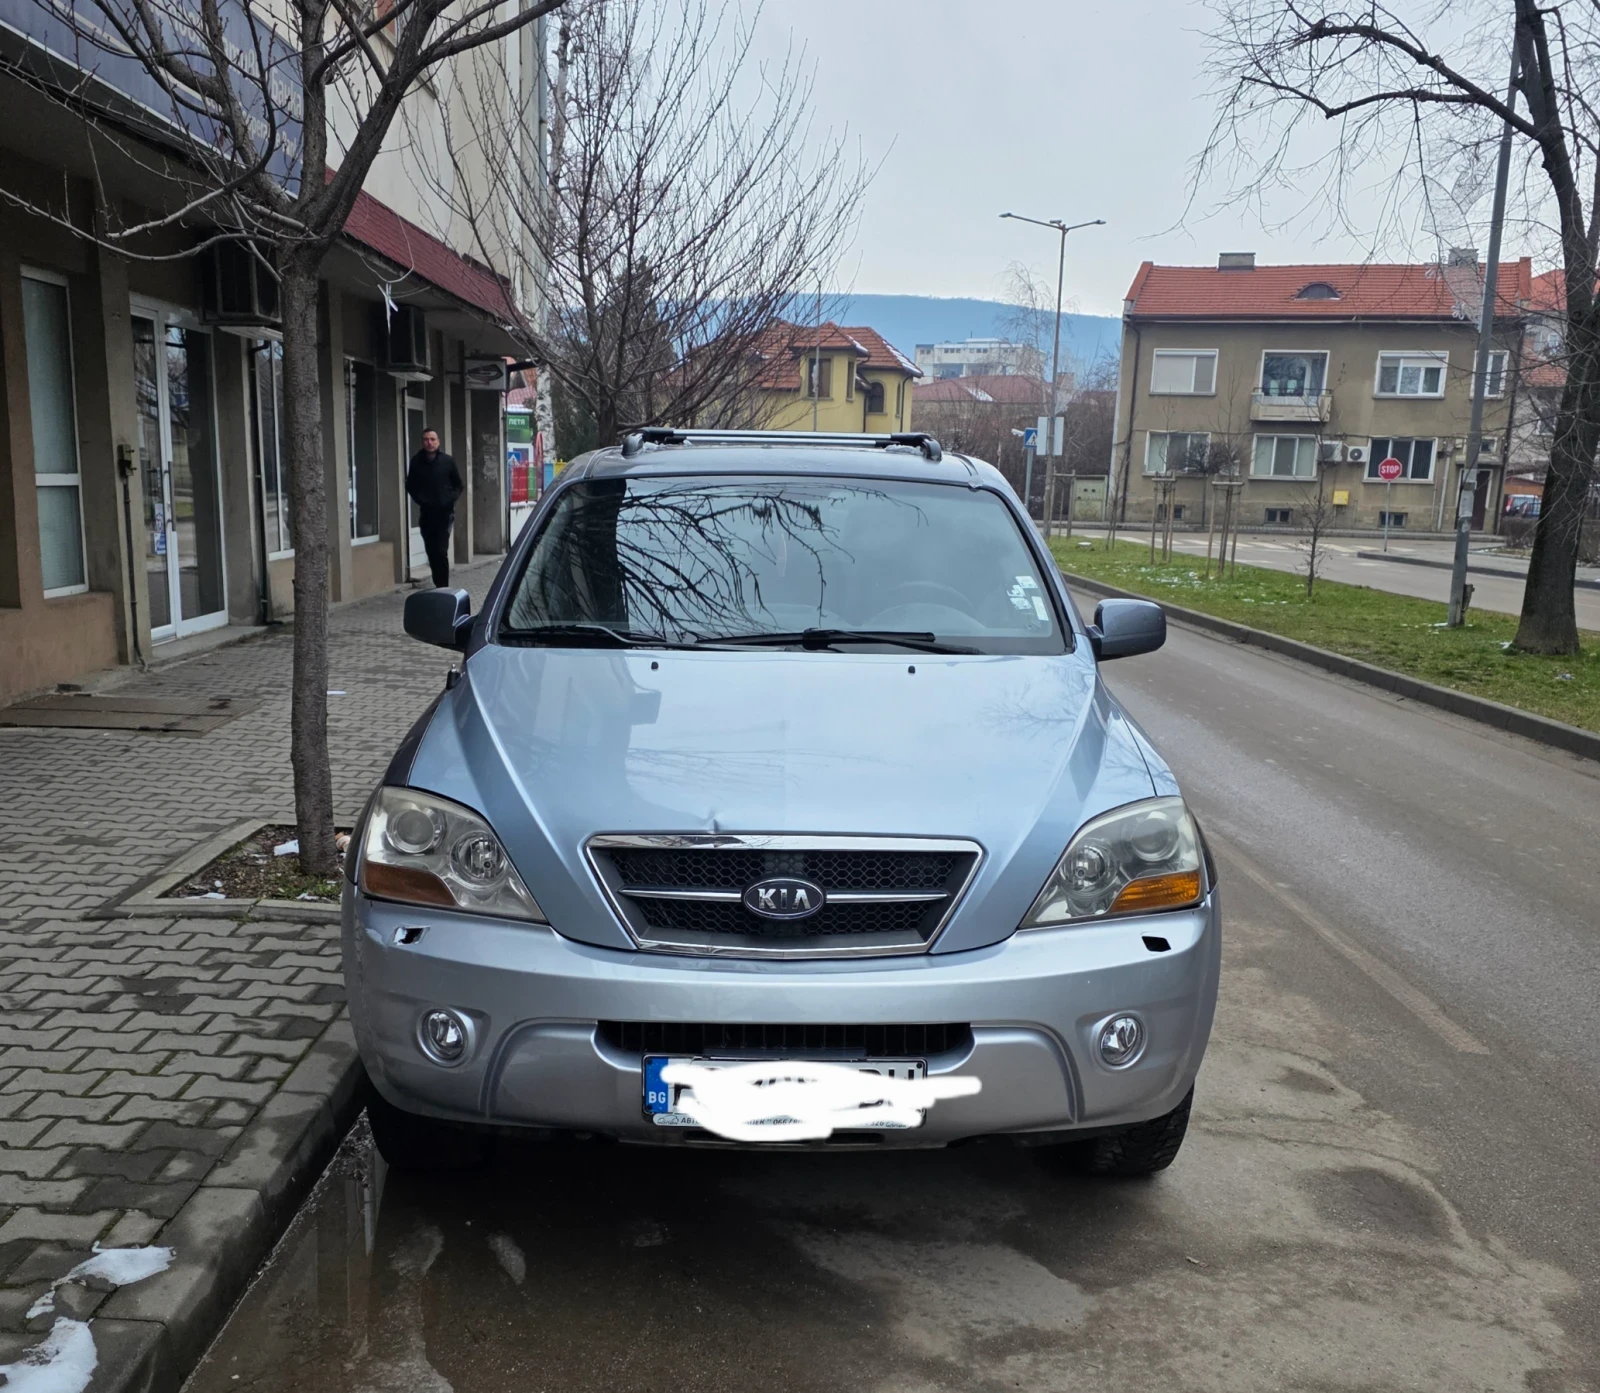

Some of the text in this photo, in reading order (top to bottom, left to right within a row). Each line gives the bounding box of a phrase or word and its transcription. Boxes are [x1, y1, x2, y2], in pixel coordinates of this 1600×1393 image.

[1381, 465, 1400, 474] STOP
[757, 888, 812, 910] KIA
[648, 1091, 667, 1104] BG
